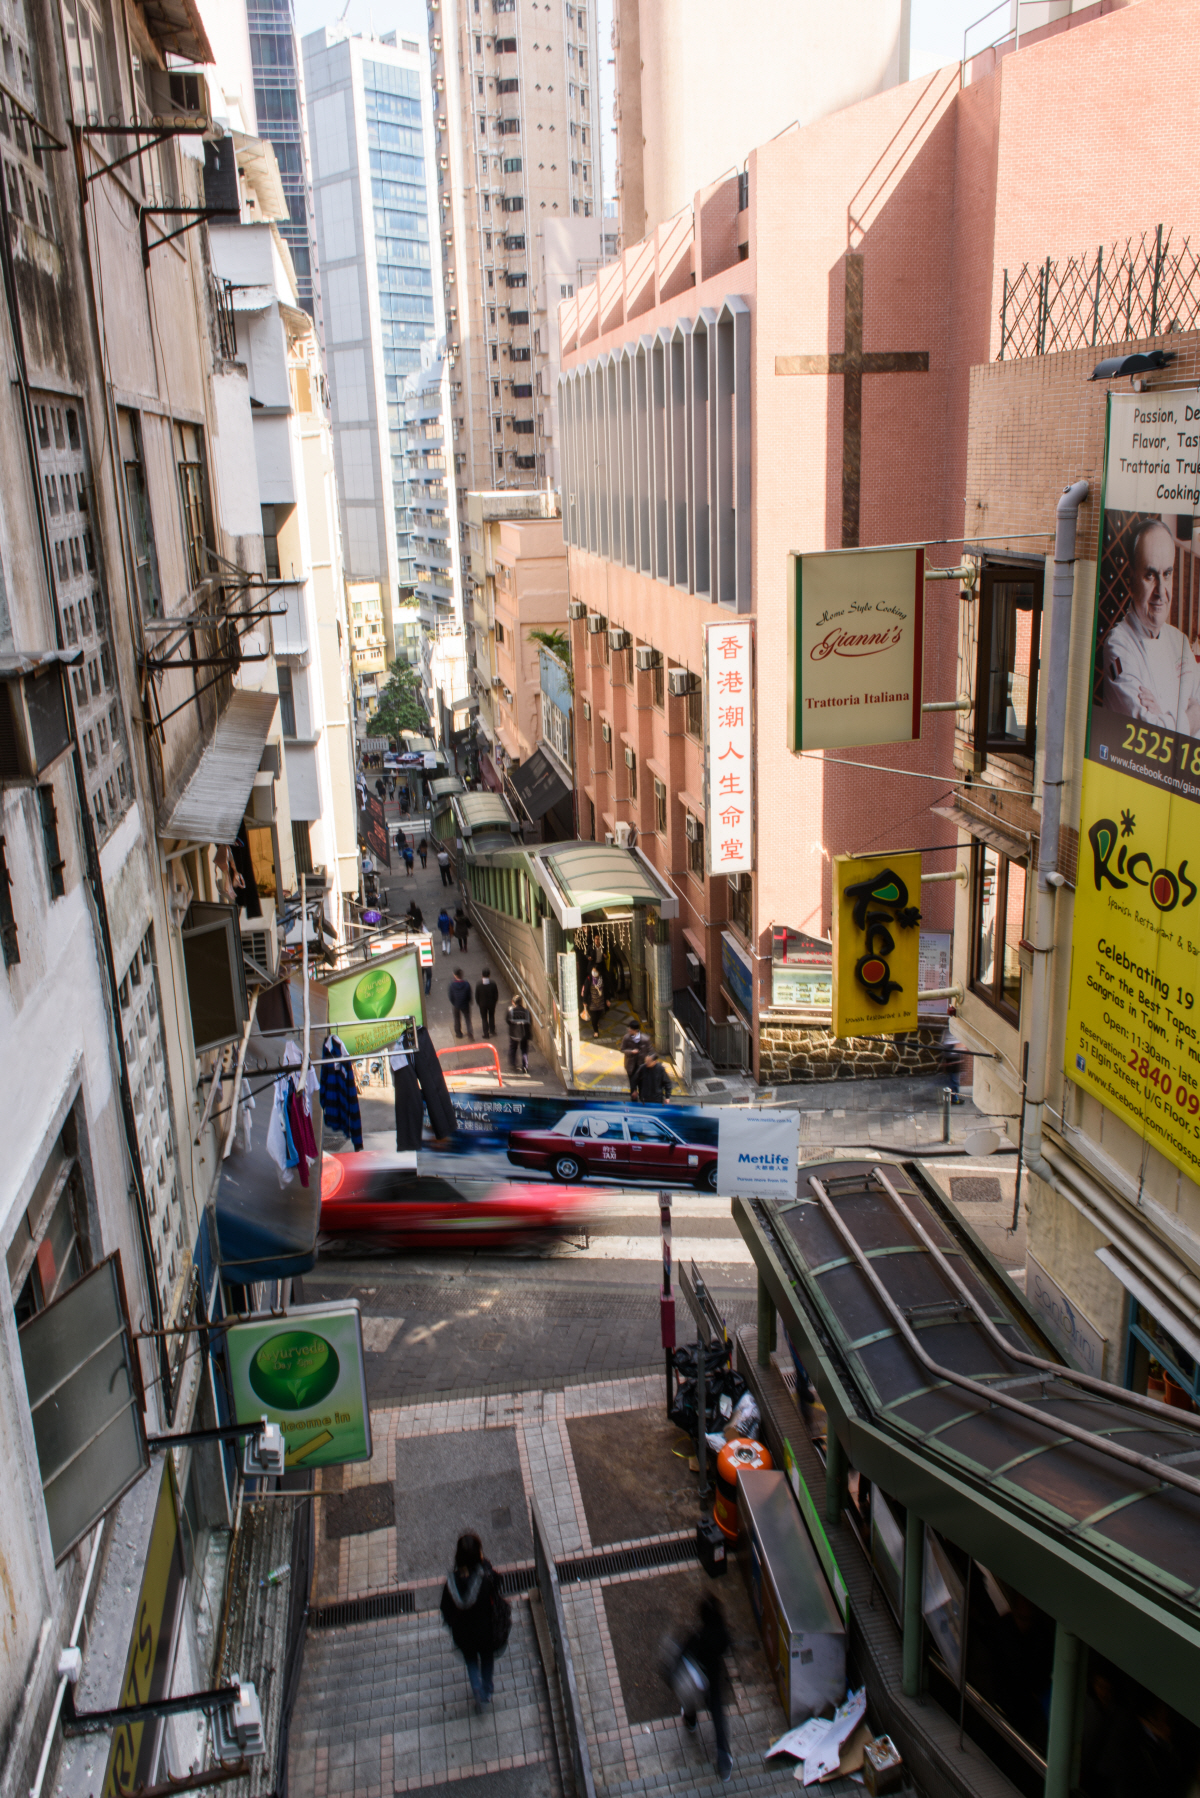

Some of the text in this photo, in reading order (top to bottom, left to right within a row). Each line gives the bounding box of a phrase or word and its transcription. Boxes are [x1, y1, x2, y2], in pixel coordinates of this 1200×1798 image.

[1134, 408, 1178, 424] Passion,
[1132, 432, 1200, 451] Flavor, Tas
[1119, 458, 1170, 474] Trattoria
[1156, 484, 1200, 505] Cooking
[816, 600, 907, 626] Home Style Cooking
[810, 625, 903, 661] Gianni's
[805, 691, 910, 709] Trattoria Italiana
[716, 635, 745, 861] 香港潮人生命堂
[1122, 723, 1175, 764] 2525
[1107, 896, 1132, 918] Spanish
[1134, 910, 1175, 942] Restaurant
[1177, 936, 1184, 950] &
[1097, 938, 1195, 1010] Celebrating 19
[1086, 975, 1125, 1009] Sangrias
[1129, 1002, 1137, 1019] in
[1140, 1009, 1170, 1043] Town,
[1175, 1034, 1184, 1051] it
[1119, 978, 1134, 997] the
[1138, 988, 1160, 1015] Best
[1102, 1011, 1130, 1040] Open:
[1130, 1031, 1171, 1071] 11:30am
[1178, 1065, 1198, 1090] late
[1079, 1037, 1089, 1054] 51
[1091, 1046, 1112, 1071] Elgin
[1113, 1062, 1142, 1095] Street,
[1144, 1085, 1162, 1111] U/G
[1163, 1103, 1192, 1135] Floor,
[1080, 1021, 1200, 1120] Reservations 2840 09
[738, 1153, 789, 1165] MetLife
[1034, 1275, 1095, 1365] Santorini
[273, 1361, 292, 1371] Day
[279, 1411, 350, 1433] lcome in
[107, 1601, 152, 1798] RITS
